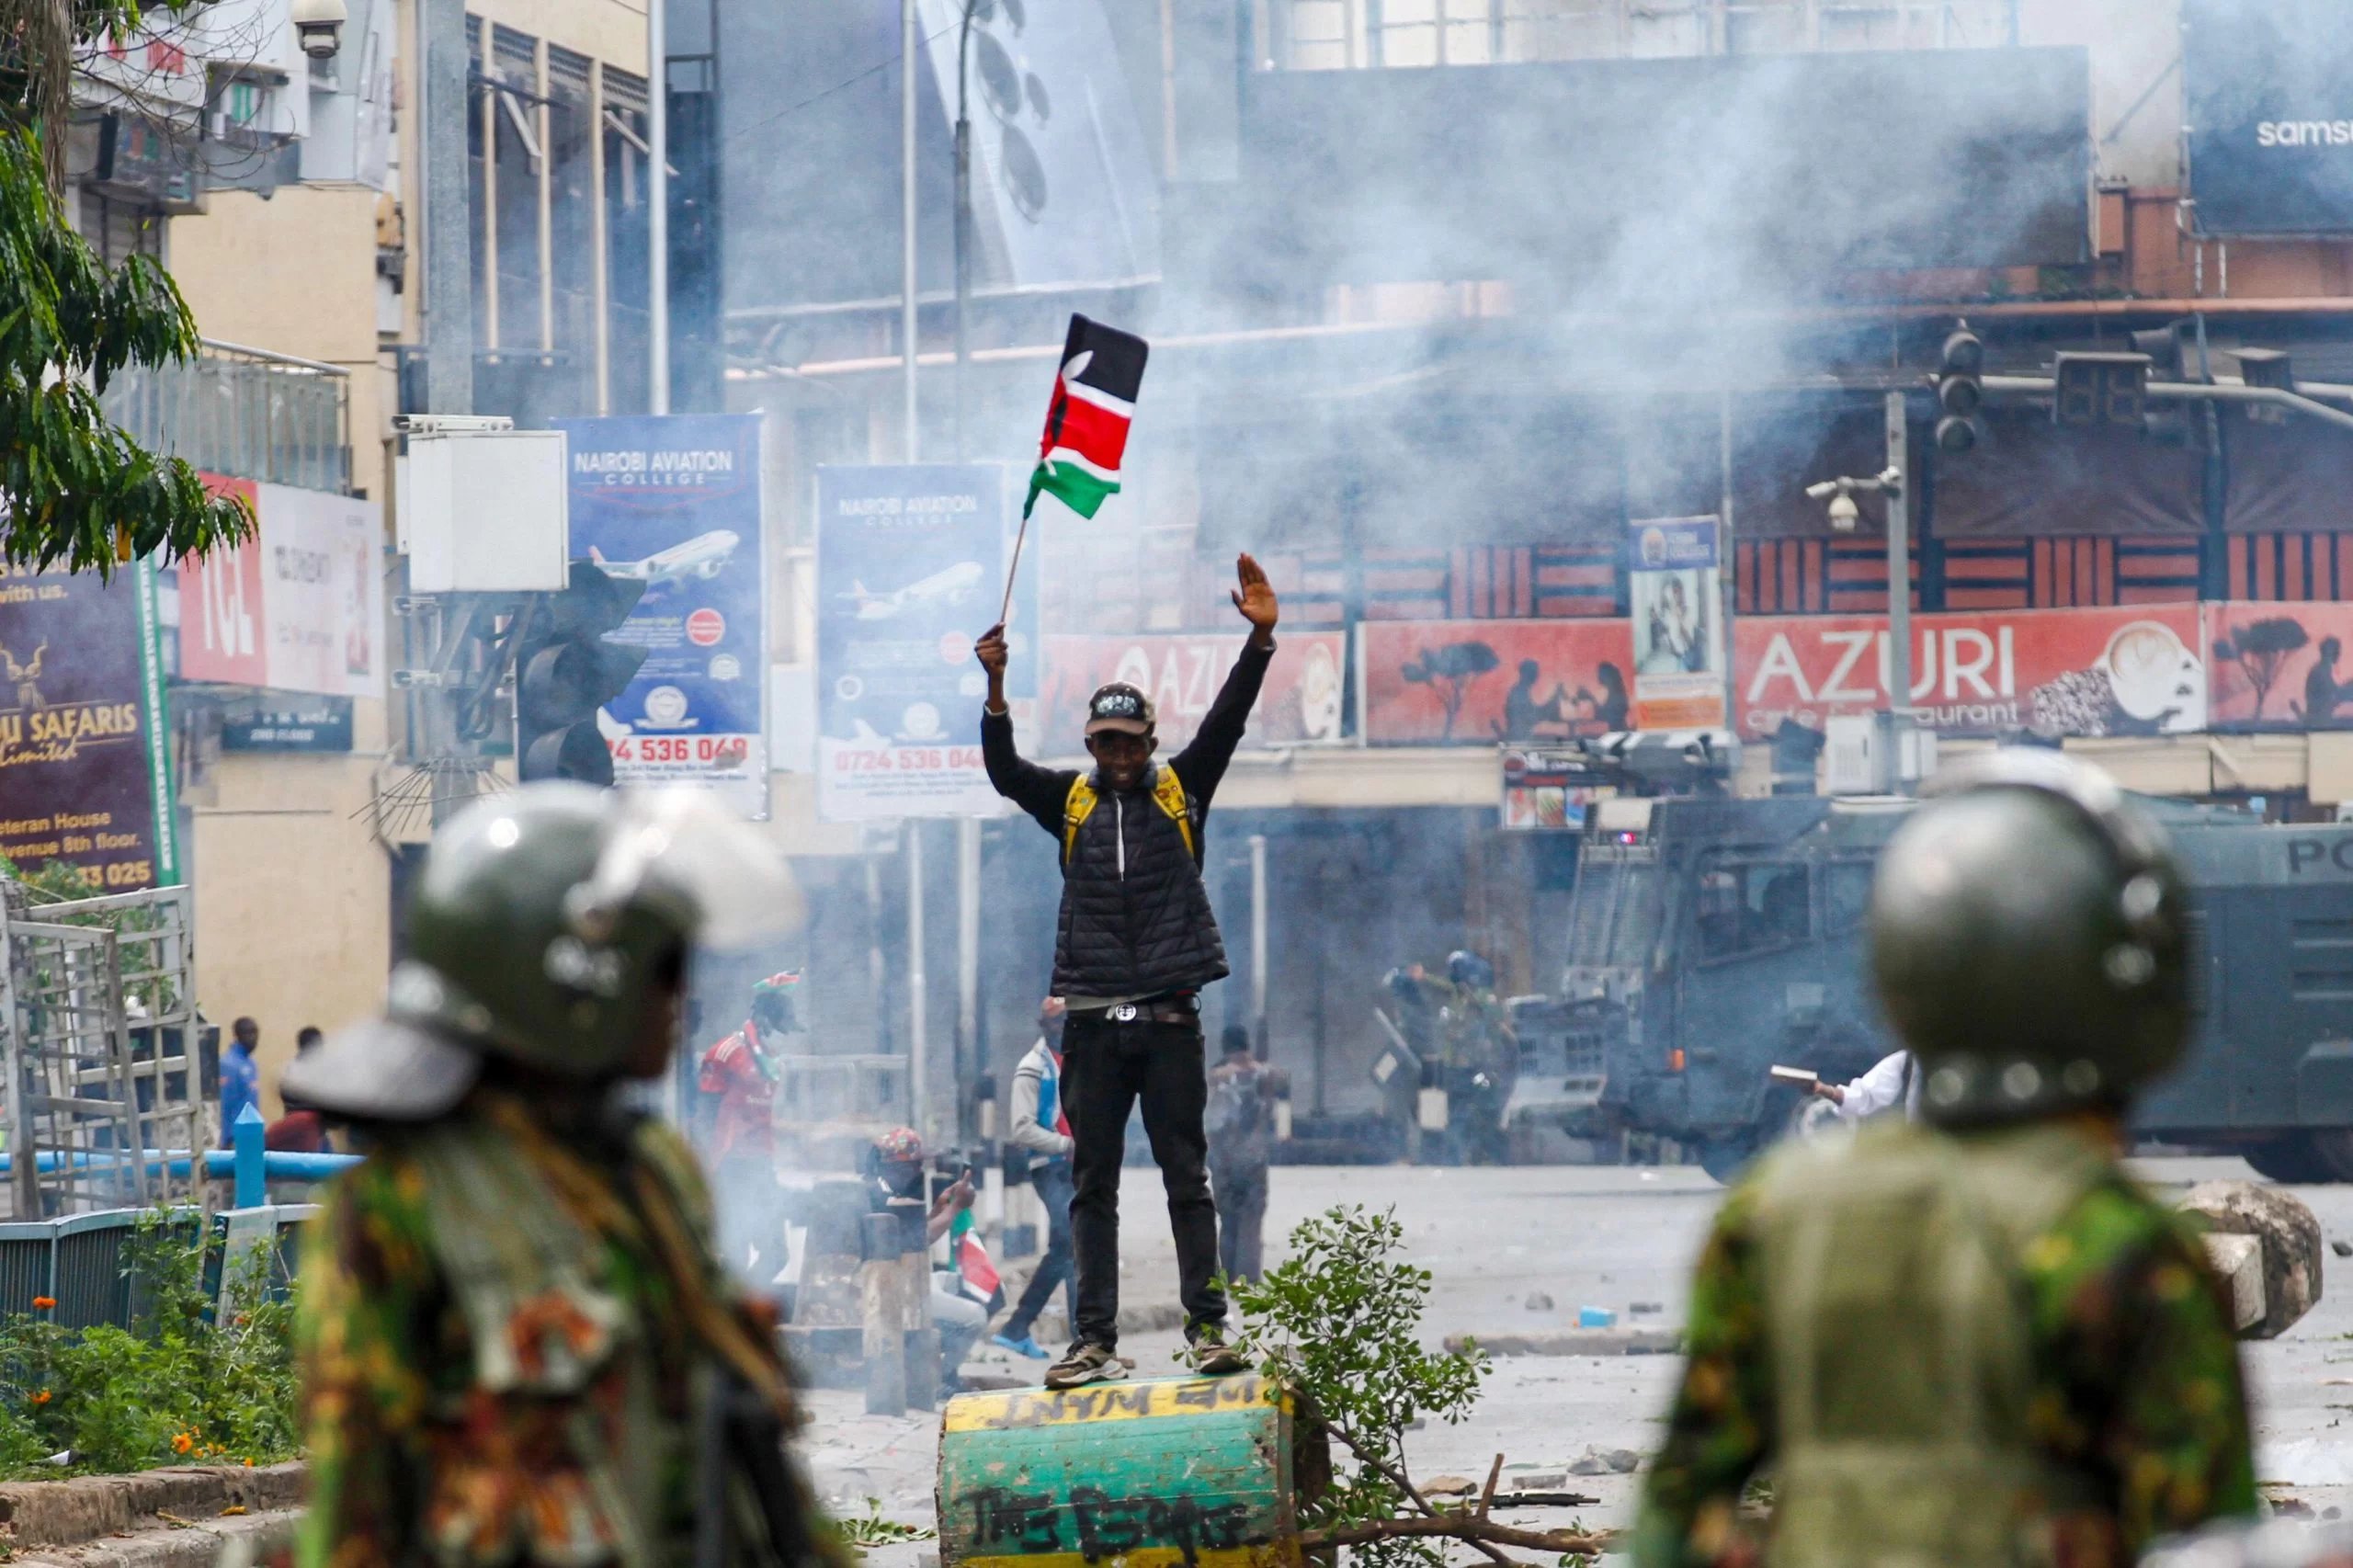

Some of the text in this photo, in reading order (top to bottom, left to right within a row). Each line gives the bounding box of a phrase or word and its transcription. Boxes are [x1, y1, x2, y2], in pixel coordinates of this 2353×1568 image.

[2256, 120, 2353, 147] sams
[574, 449, 733, 472] NAIROBI AVIATION
[605, 473, 705, 485] COLLEGE
[1746, 626, 2016, 702] AZURI
[29, 702, 137, 742] SAFARIS
[641, 738, 688, 761] 536
[949, 746, 986, 768] 04
[55, 812, 111, 829] House
[0, 841, 60, 858] venue
[107, 860, 153, 886] 025
